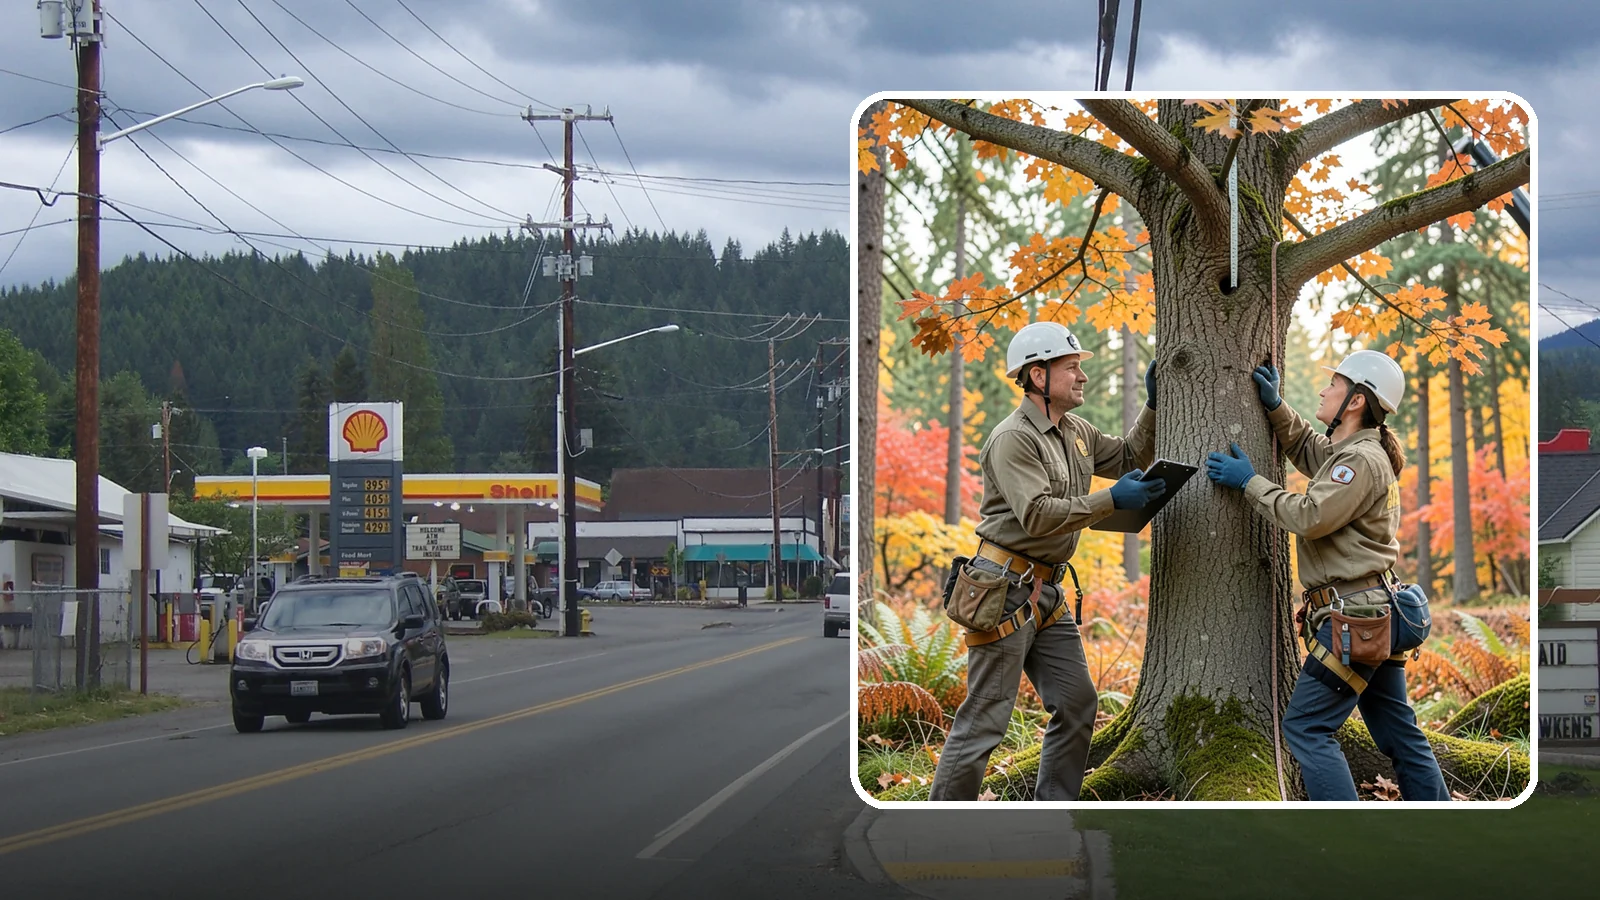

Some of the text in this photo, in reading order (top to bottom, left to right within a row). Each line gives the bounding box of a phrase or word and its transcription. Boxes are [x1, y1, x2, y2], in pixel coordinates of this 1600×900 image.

[366, 480, 383, 490] 395
[490, 484, 547, 499] Shell
[366, 494, 383, 504] 405
[366, 508, 383, 518] 415
[366, 522, 383, 532] 429
